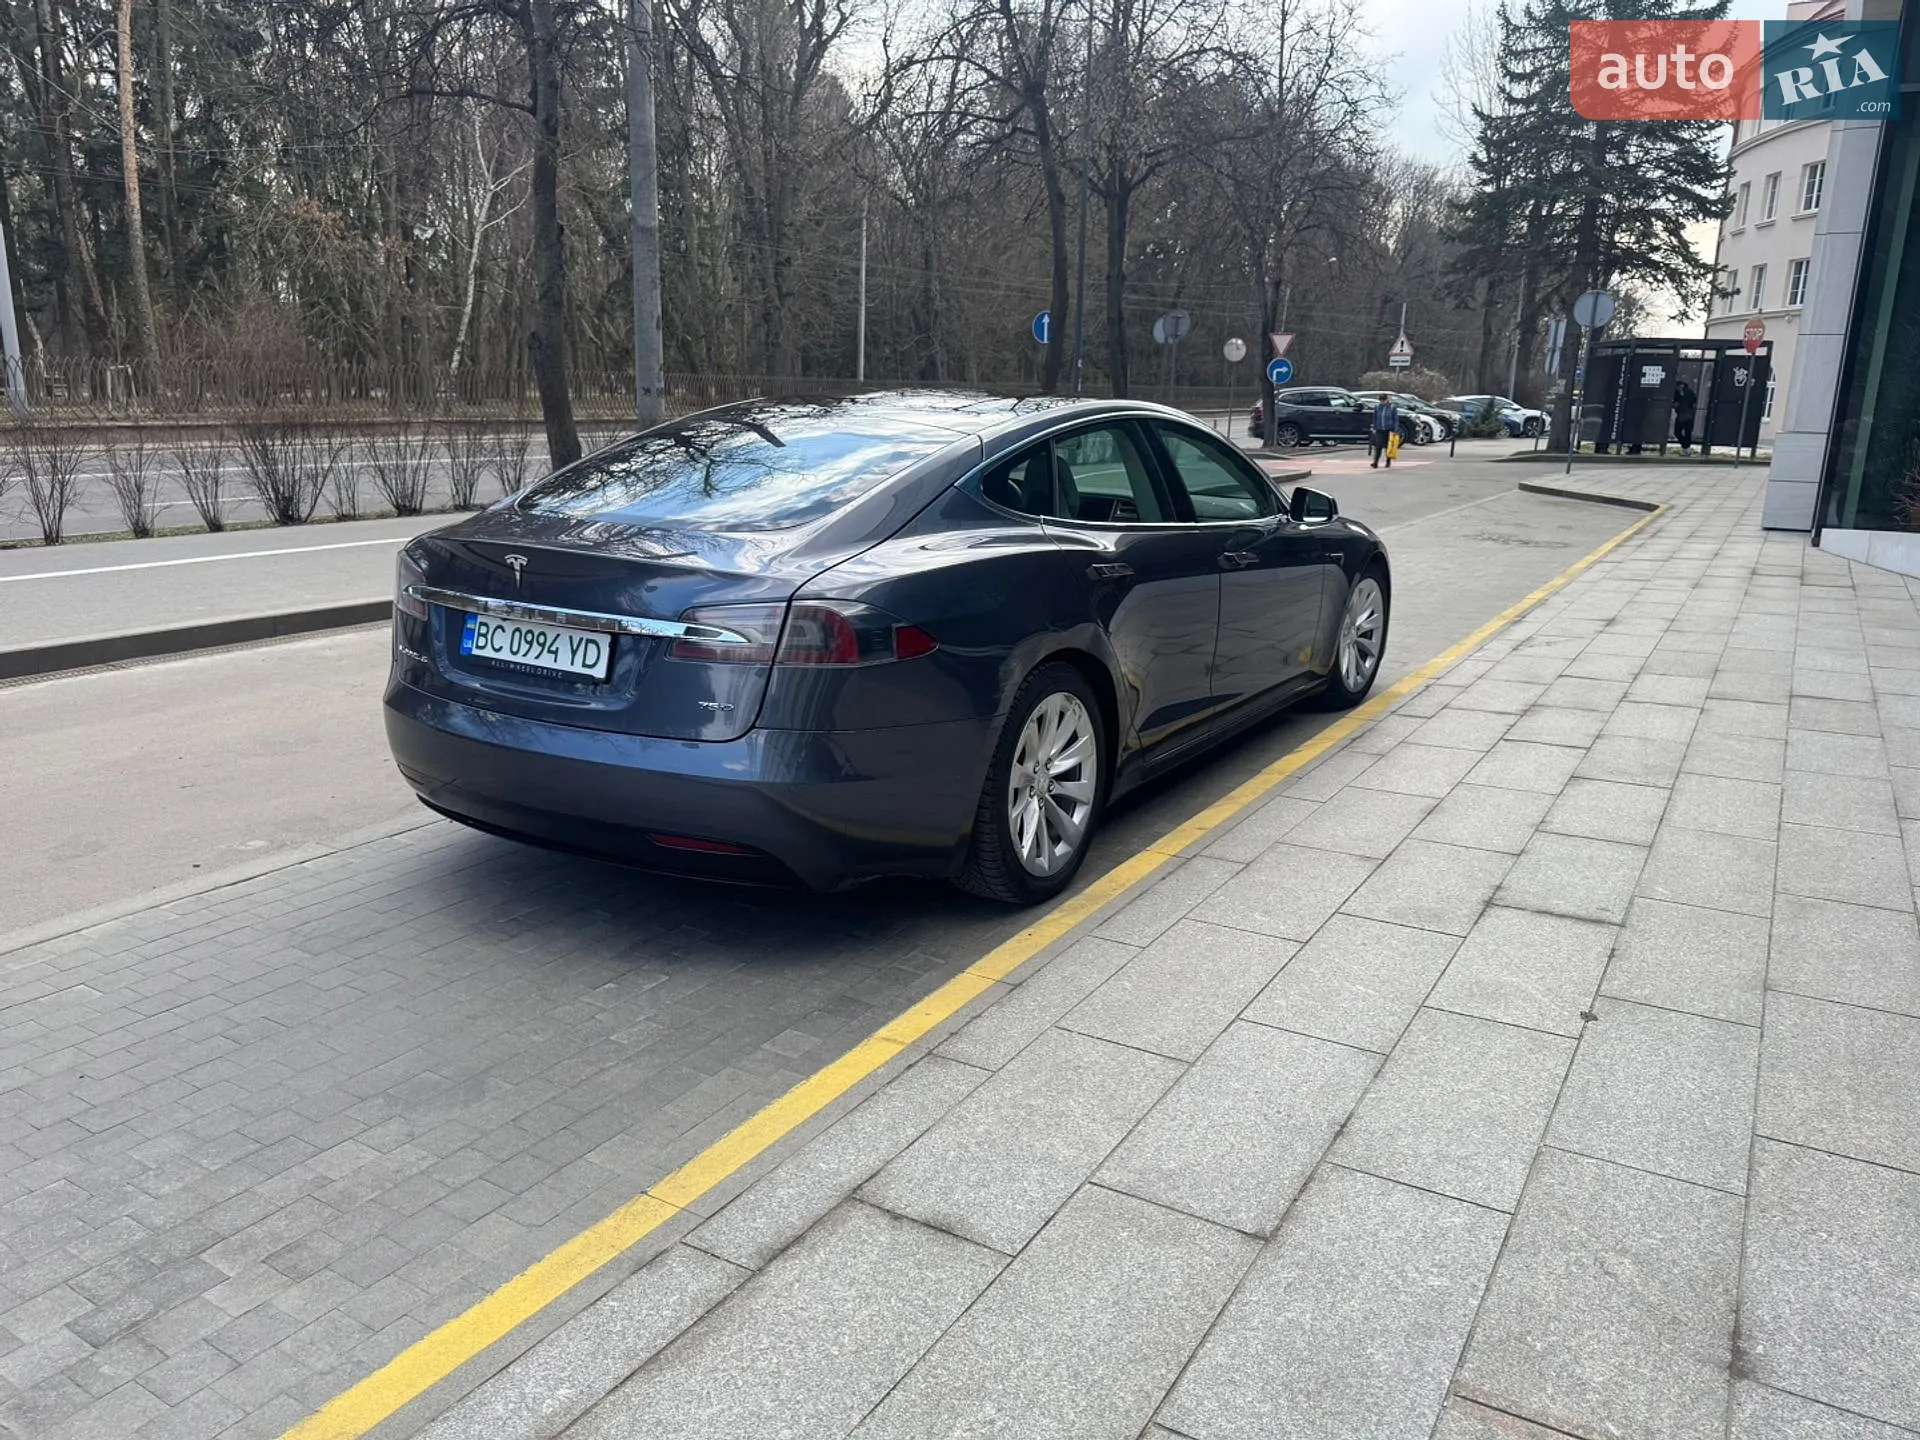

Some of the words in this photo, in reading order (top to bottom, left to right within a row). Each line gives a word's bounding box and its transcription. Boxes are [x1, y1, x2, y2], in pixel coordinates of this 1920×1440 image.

[1743, 327, 1764, 341] STOP
[475, 621, 506, 653] BC
[509, 627, 561, 663] 0994
[568, 635, 601, 669] YD
